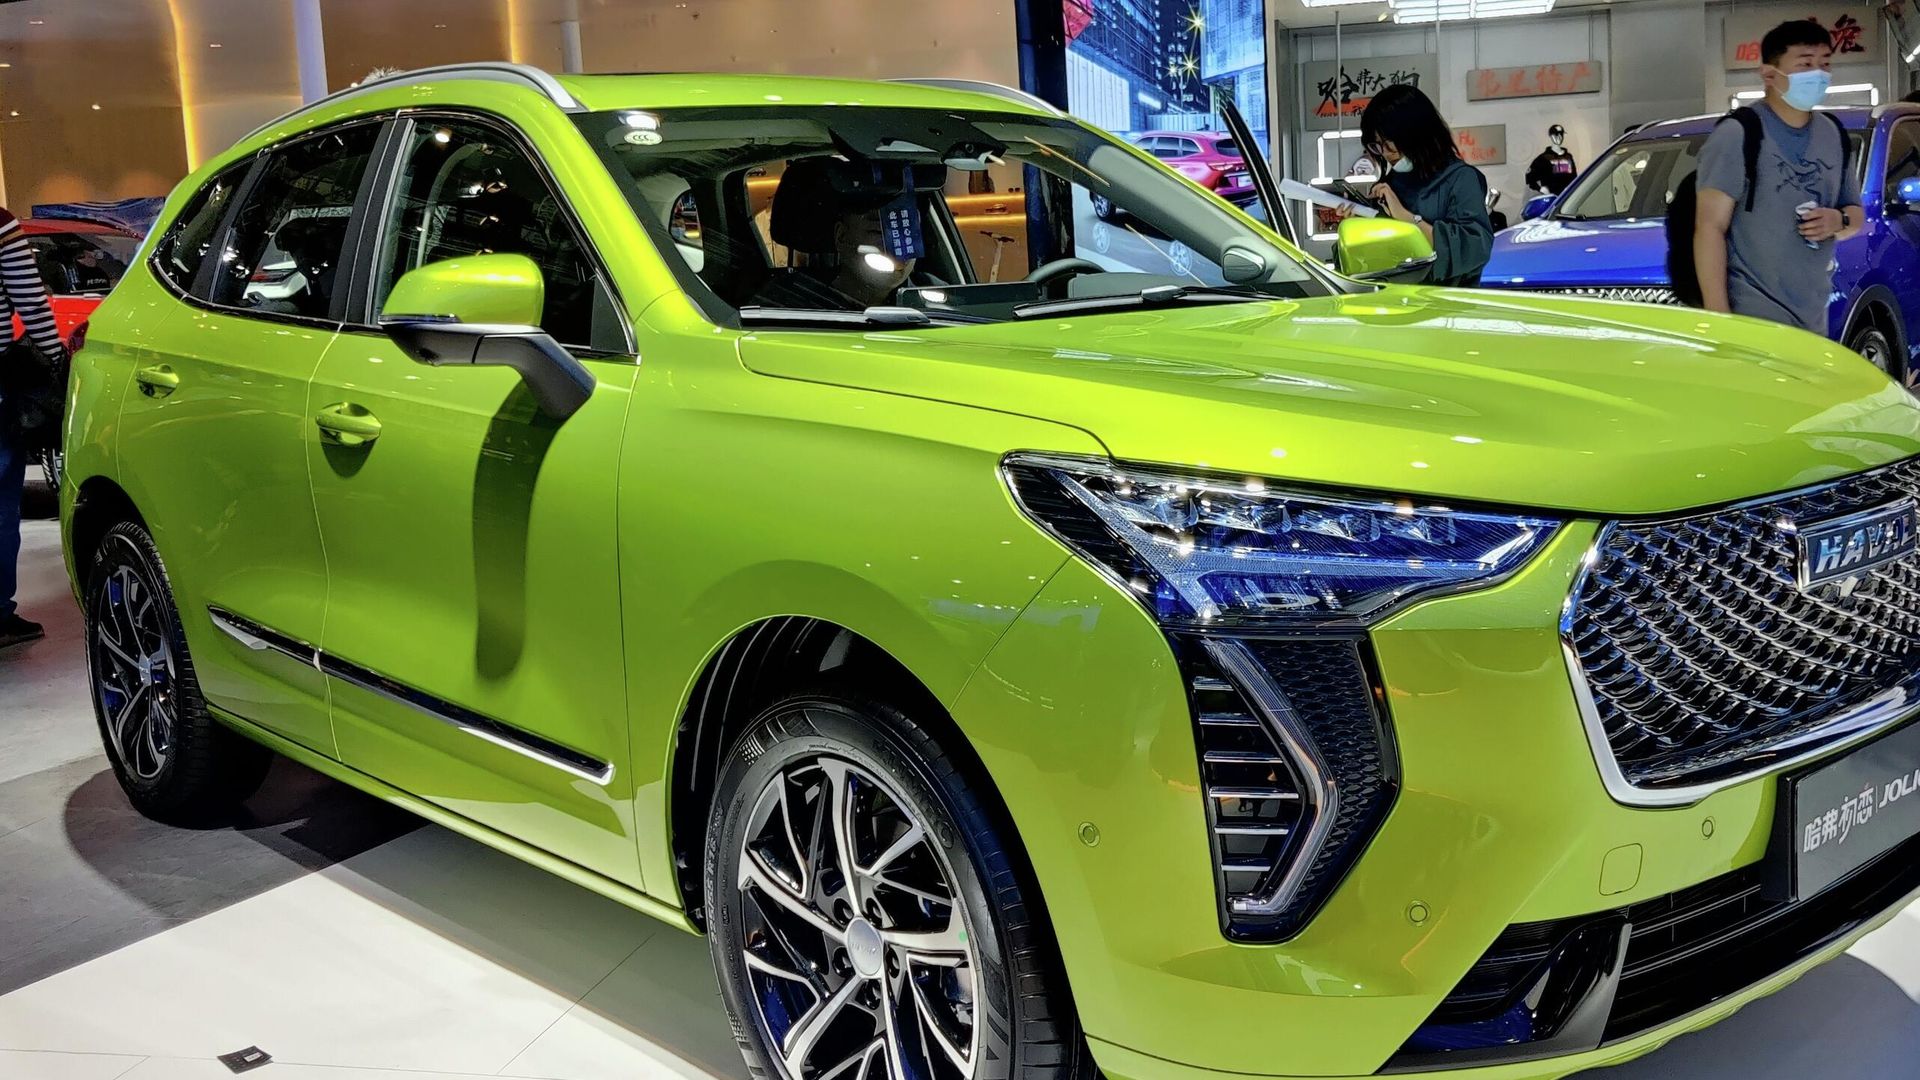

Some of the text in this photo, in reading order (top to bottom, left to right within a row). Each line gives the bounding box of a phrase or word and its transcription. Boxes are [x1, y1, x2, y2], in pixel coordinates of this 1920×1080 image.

[889, 211, 902, 256] 此车已消毒
[900, 209, 914, 254] 请放心参观
[1815, 513, 1915, 574] HAVAL
[1803, 782, 1874, 853] 哈弗初恋
